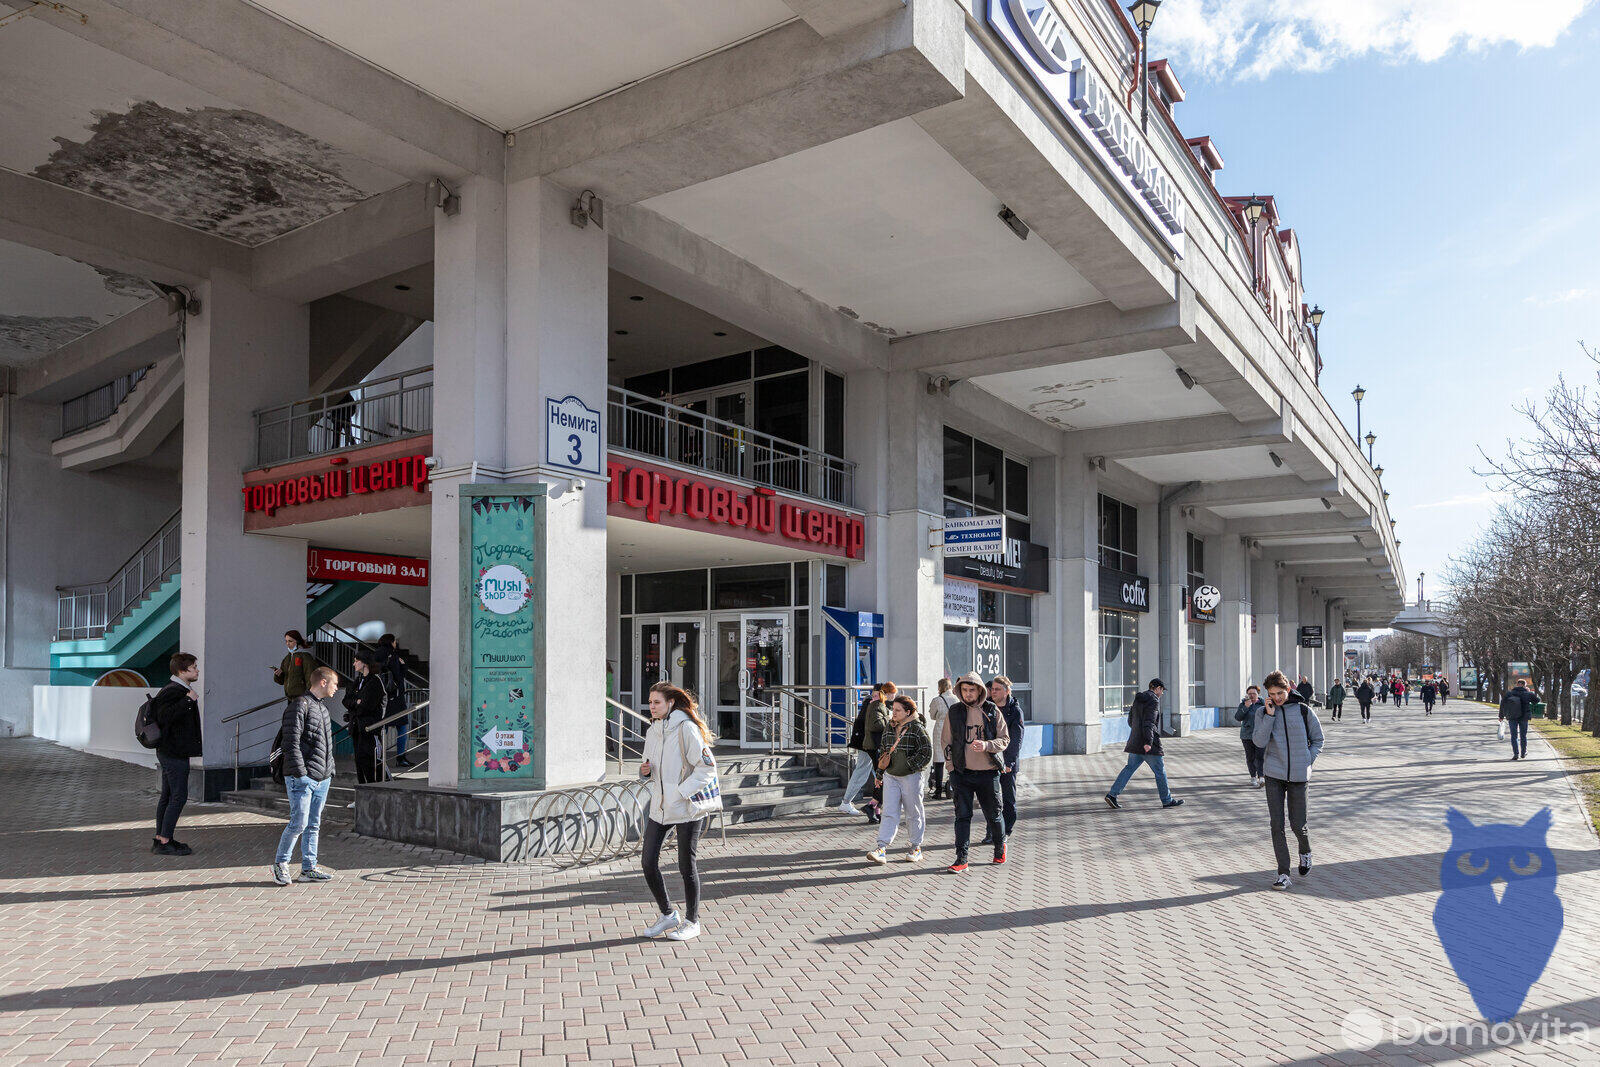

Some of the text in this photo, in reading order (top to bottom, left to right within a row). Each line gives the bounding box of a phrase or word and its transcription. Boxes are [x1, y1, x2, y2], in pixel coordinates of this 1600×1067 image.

[1070, 58, 1183, 235] ТЕХНОБАНК
[551, 405, 598, 434] Немига
[567, 433, 583, 465] 3
[945, 520, 985, 529] БАНКОМАТ
[960, 531, 1001, 540] ТЕХНОБАНК
[474, 541, 534, 565] Подарки
[946, 543, 1000, 553] ОБМЕН ВАЛЮТ
[323, 558, 427, 578] ТОРГОВЫЙ ЗАЛ
[951, 593, 968, 603] ТОВАРОВ
[1122, 579, 1146, 606] cofix
[976, 630, 1001, 650] cofix
